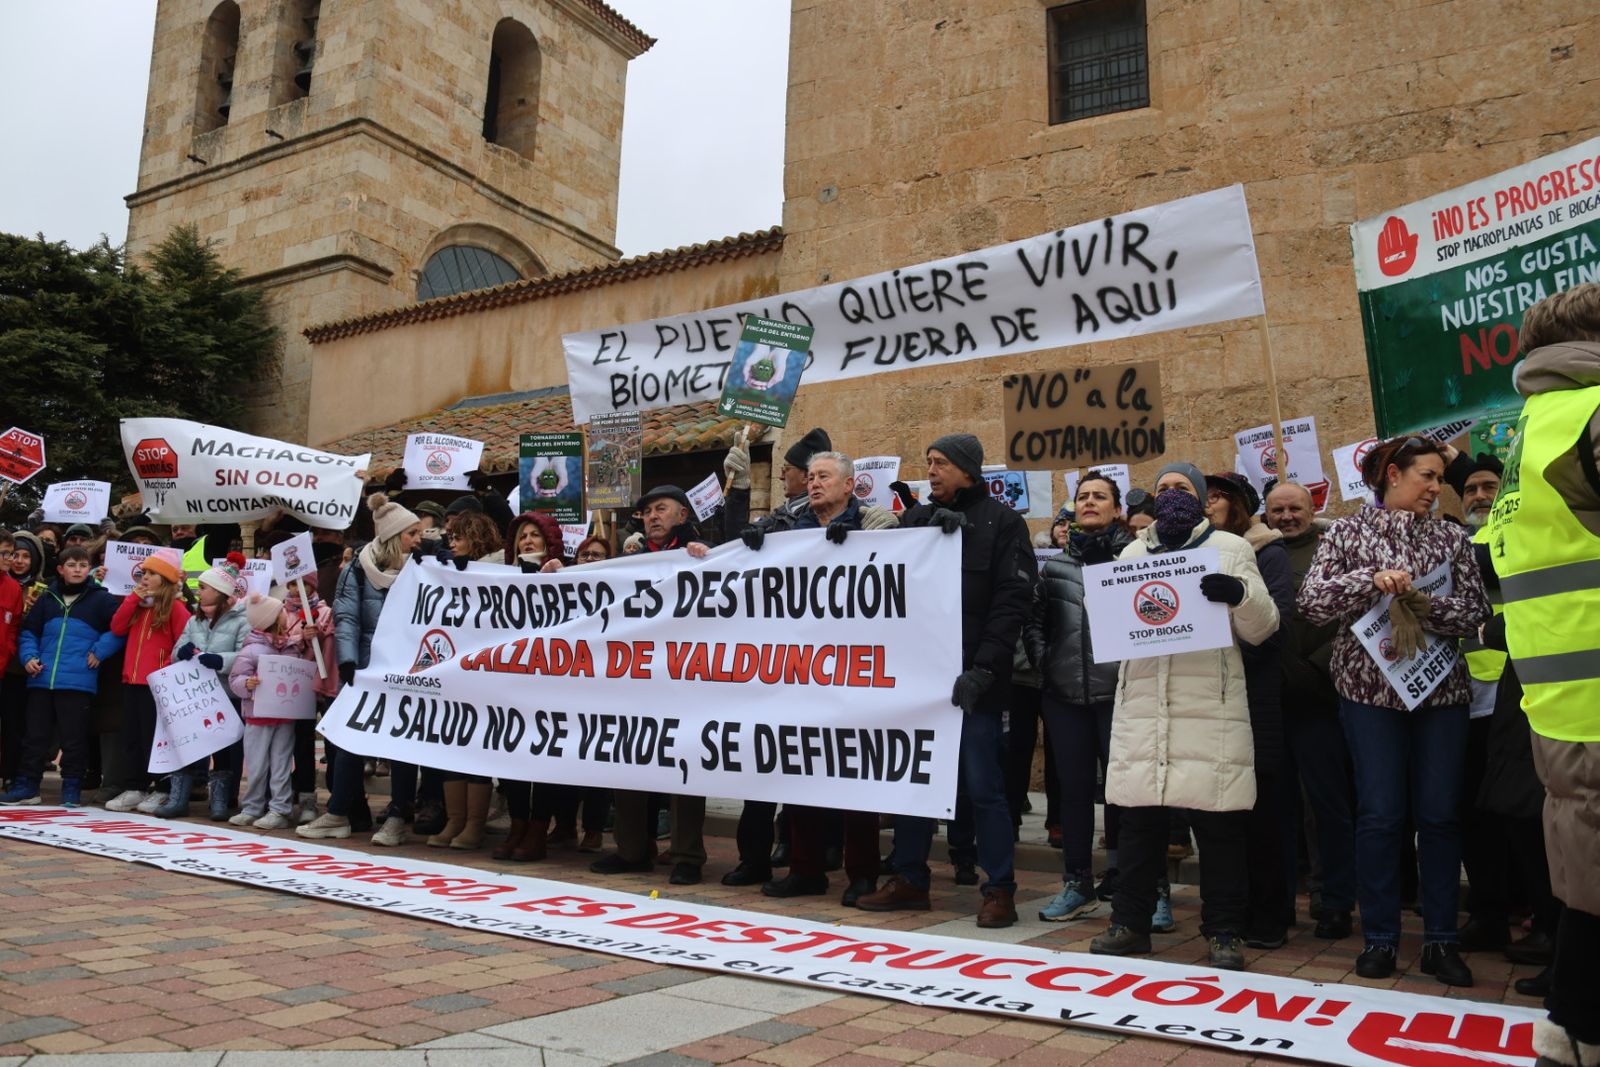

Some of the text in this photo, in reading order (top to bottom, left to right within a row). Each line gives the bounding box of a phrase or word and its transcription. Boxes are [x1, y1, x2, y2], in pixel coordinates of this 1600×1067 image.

[1468, 196, 1490, 231] ES
[1436, 191, 1600, 262] STOP MACROPLANTAS DE BIOGÁ
[1465, 232, 1598, 292] NOS GUSTA
[593, 331, 631, 366] EL
[838, 262, 988, 325] QUIERE
[1440, 278, 1547, 332] NUESTRA
[746, 325, 810, 342] FINCAS DEL ENTORNO
[757, 319, 796, 331] TORNADIZOS
[840, 322, 977, 372] FUERA
[991, 308, 1039, 347] DE
[1458, 323, 1519, 375] NO
[1086, 389, 1106, 408] a
[1116, 367, 1152, 411] la
[10, 432, 38, 447] STOP
[1297, 423, 1311, 433] AGUA
[415, 435, 425, 445] POR
[426, 436, 433, 444] EL
[137, 447, 168, 461] STOP
[215, 469, 319, 490] SIN OLOR
[1349, 480, 1365, 491] STO
[186, 495, 354, 518] NI CONTAMINACIÓN
[116, 544, 127, 554] POR
[128, 546, 135, 555] LA
[1101, 565, 1206, 587] DE NUESTROS HIJOS
[1113, 556, 1187, 573] POR LA SALUD
[411, 552, 906, 633] NO ES PROGRESO, ES DESTRUCCIÓN
[1129, 623, 1194, 640] STOP BIOGAS
[1363, 627, 1374, 640] NO
[1370, 621, 1382, 633] ES
[605, 640, 654, 680] DE
[666, 641, 896, 688] VALDUNCIEL
[1400, 672, 1410, 684] LA
[1408, 658, 1424, 676] SALUD
[1421, 649, 1430, 661] NO
[174, 668, 200, 686] UN
[383, 673, 442, 688] STOP BIOGAS
[1406, 675, 1428, 699] SE
[346, 691, 935, 785] LA SALUD NO SE VENDE, SE DEFIENDE
[500, 895, 638, 918] ES
[604, 911, 1352, 1027] DESTRUCCIÓN!
[409, 904, 717, 962] macrogranjas
[722, 959, 795, 976] en
[806, 970, 1035, 1012] Castilla
[1113, 1013, 1295, 1050] León
